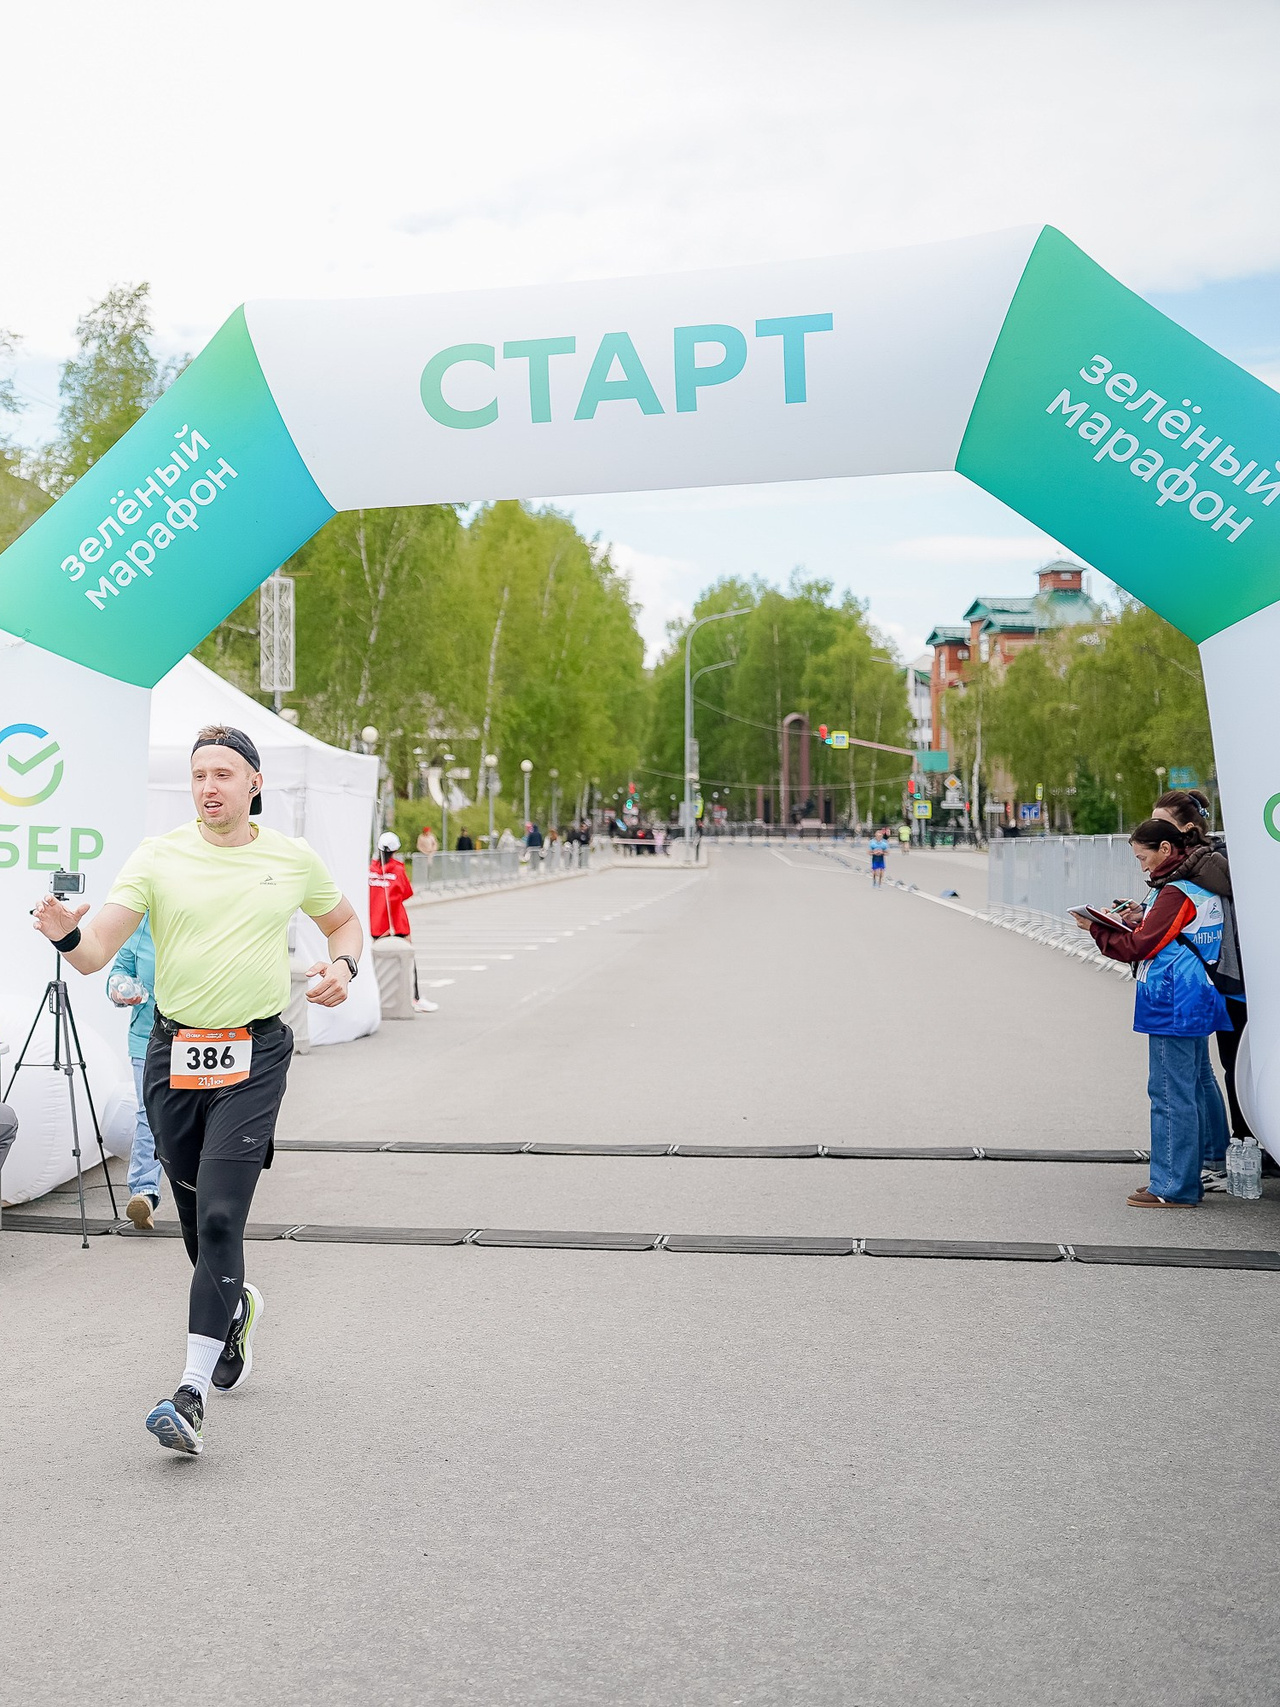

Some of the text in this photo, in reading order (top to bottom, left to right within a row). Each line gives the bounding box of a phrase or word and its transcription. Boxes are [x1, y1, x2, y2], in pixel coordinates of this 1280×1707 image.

[420, 312, 834, 430] СТАРТ
[1078, 354, 1280, 507] зелёный
[60, 423, 212, 582] зелёный
[84, 457, 239, 611] марафон
[1045, 387, 1254, 543] марафон
[187, 1046, 235, 1070] 386
